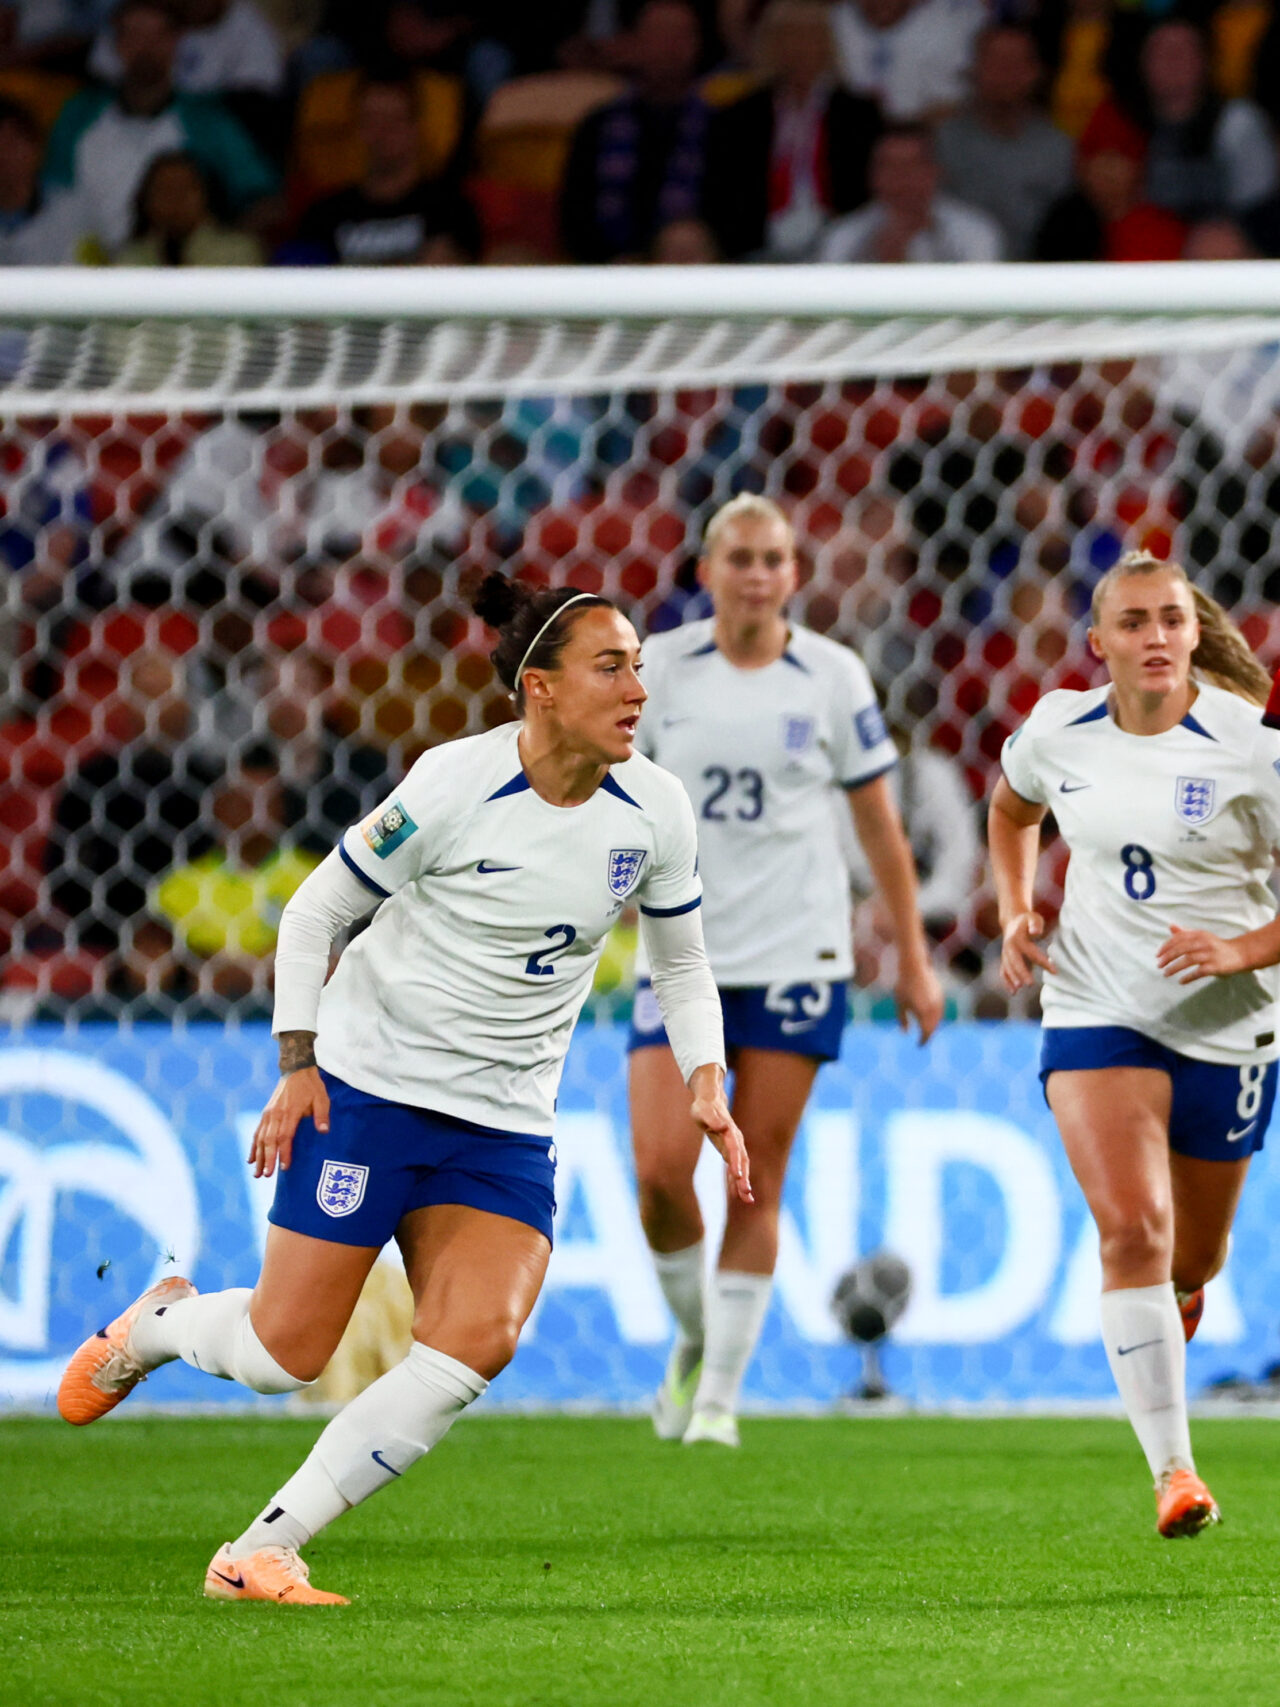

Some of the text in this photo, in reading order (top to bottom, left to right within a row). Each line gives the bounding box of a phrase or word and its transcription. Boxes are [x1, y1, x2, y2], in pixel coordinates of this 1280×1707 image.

[702, 765, 763, 821] 23
[1121, 844, 1156, 900] 8
[525, 924, 576, 975] 2
[1237, 1064, 1267, 1119] 8
